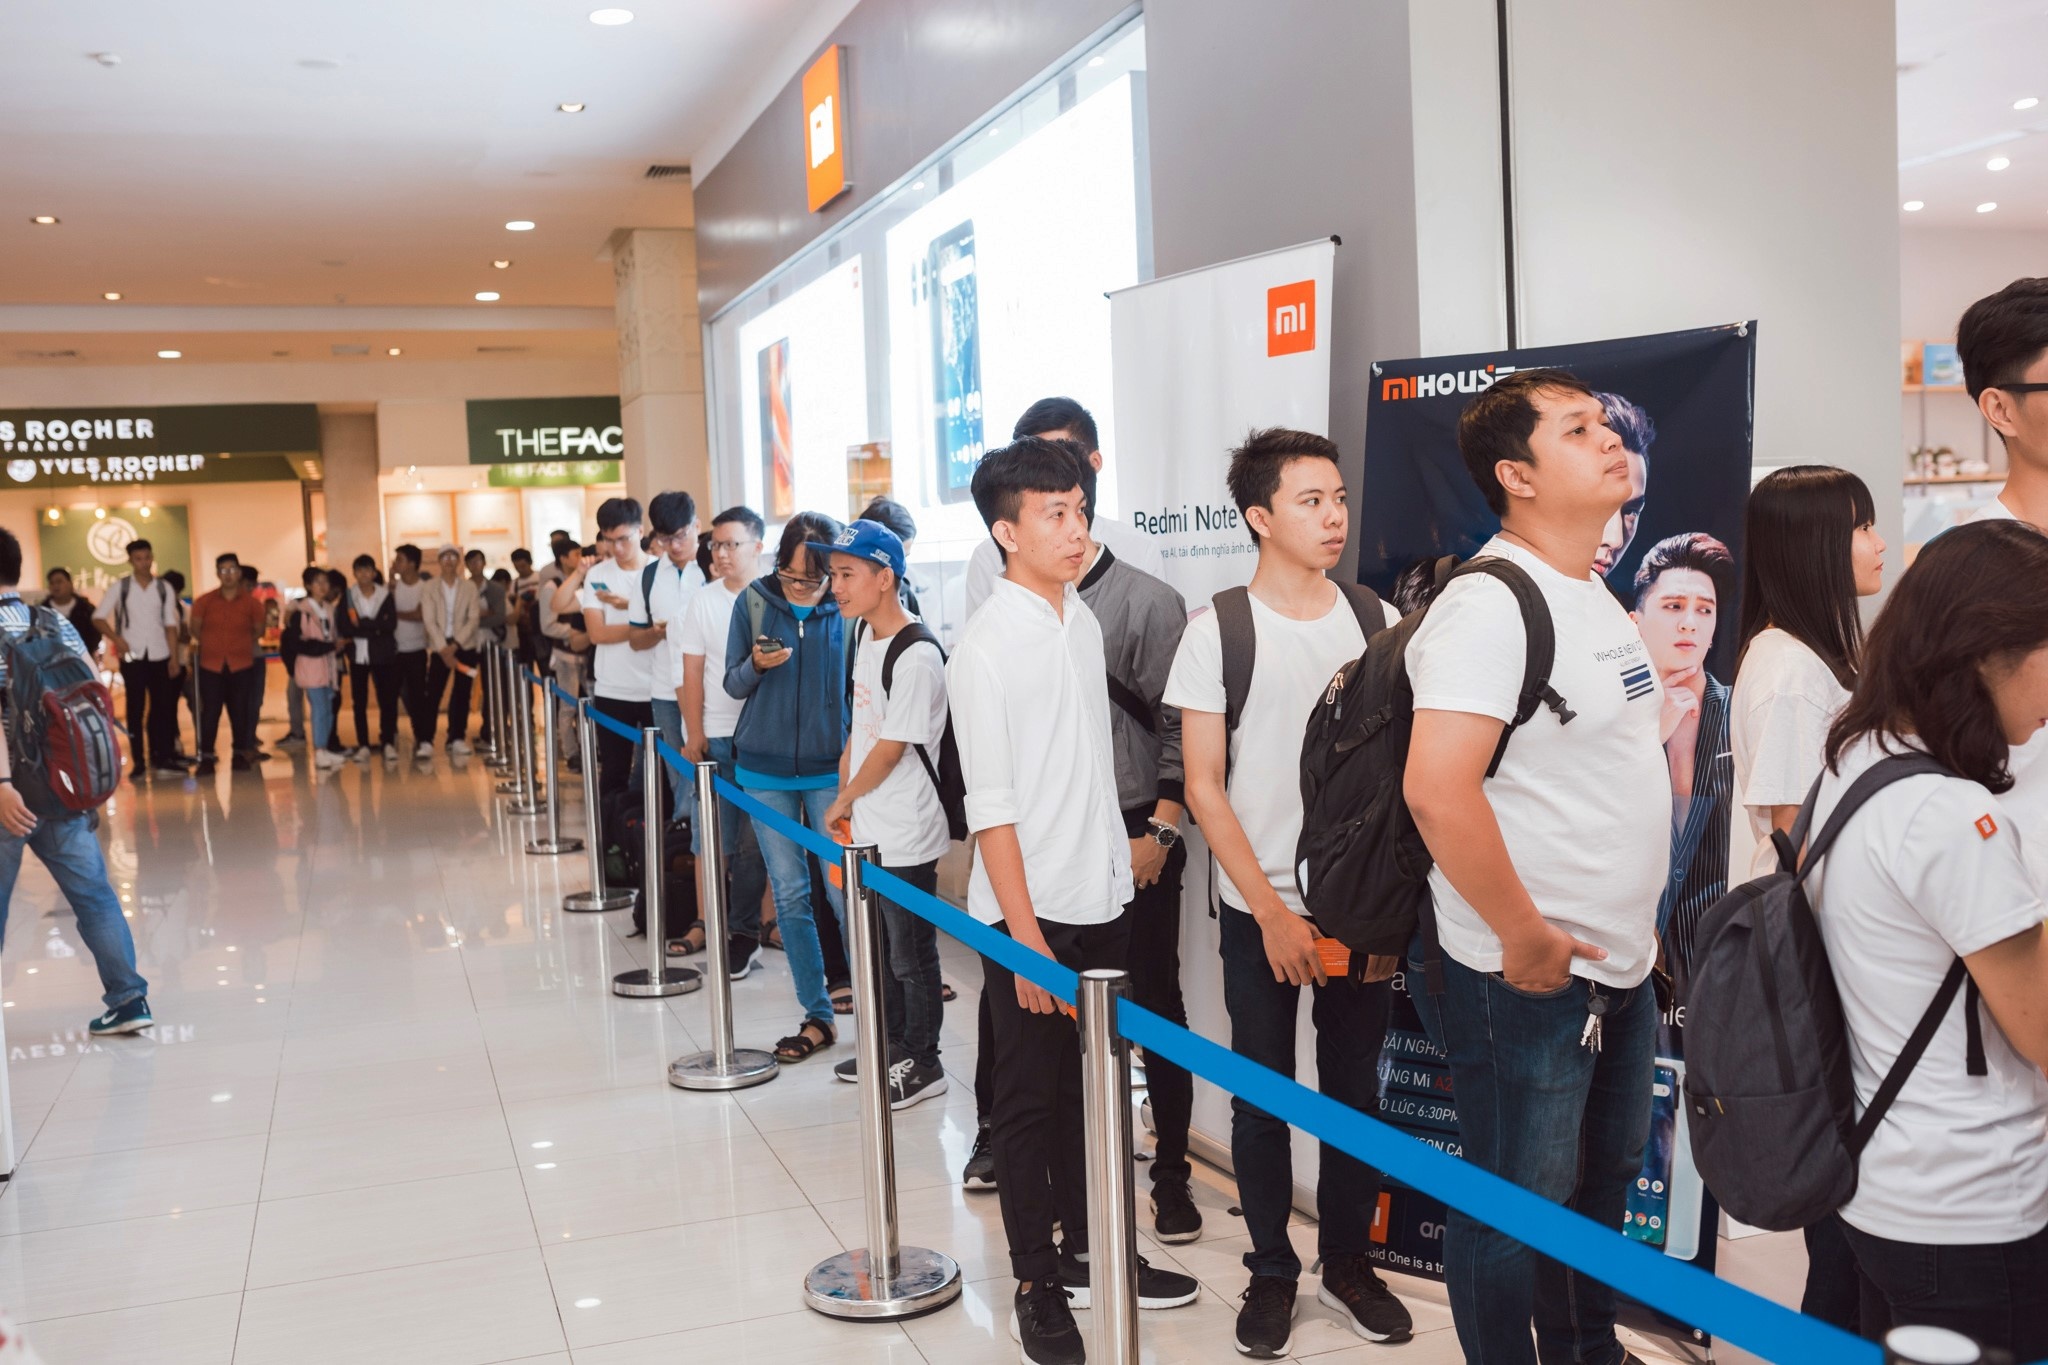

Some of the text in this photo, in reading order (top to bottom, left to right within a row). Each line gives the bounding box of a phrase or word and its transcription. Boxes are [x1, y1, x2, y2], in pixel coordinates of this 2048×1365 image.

[25, 418, 154, 441] ROCHER
[39, 454, 205, 475] YVES ROCHER
[1134, 504, 1238, 535] Redmi Note
[1593, 646, 1625, 663] WHOLE
[1377, 1063, 1454, 1092] ÙNG Mi A2
[1391, 1098, 1416, 1115] LÚC
[1388, 1250, 1411, 1266] One
[1413, 1256, 1423, 1269] is
[1425, 1261, 1433, 1271] a
